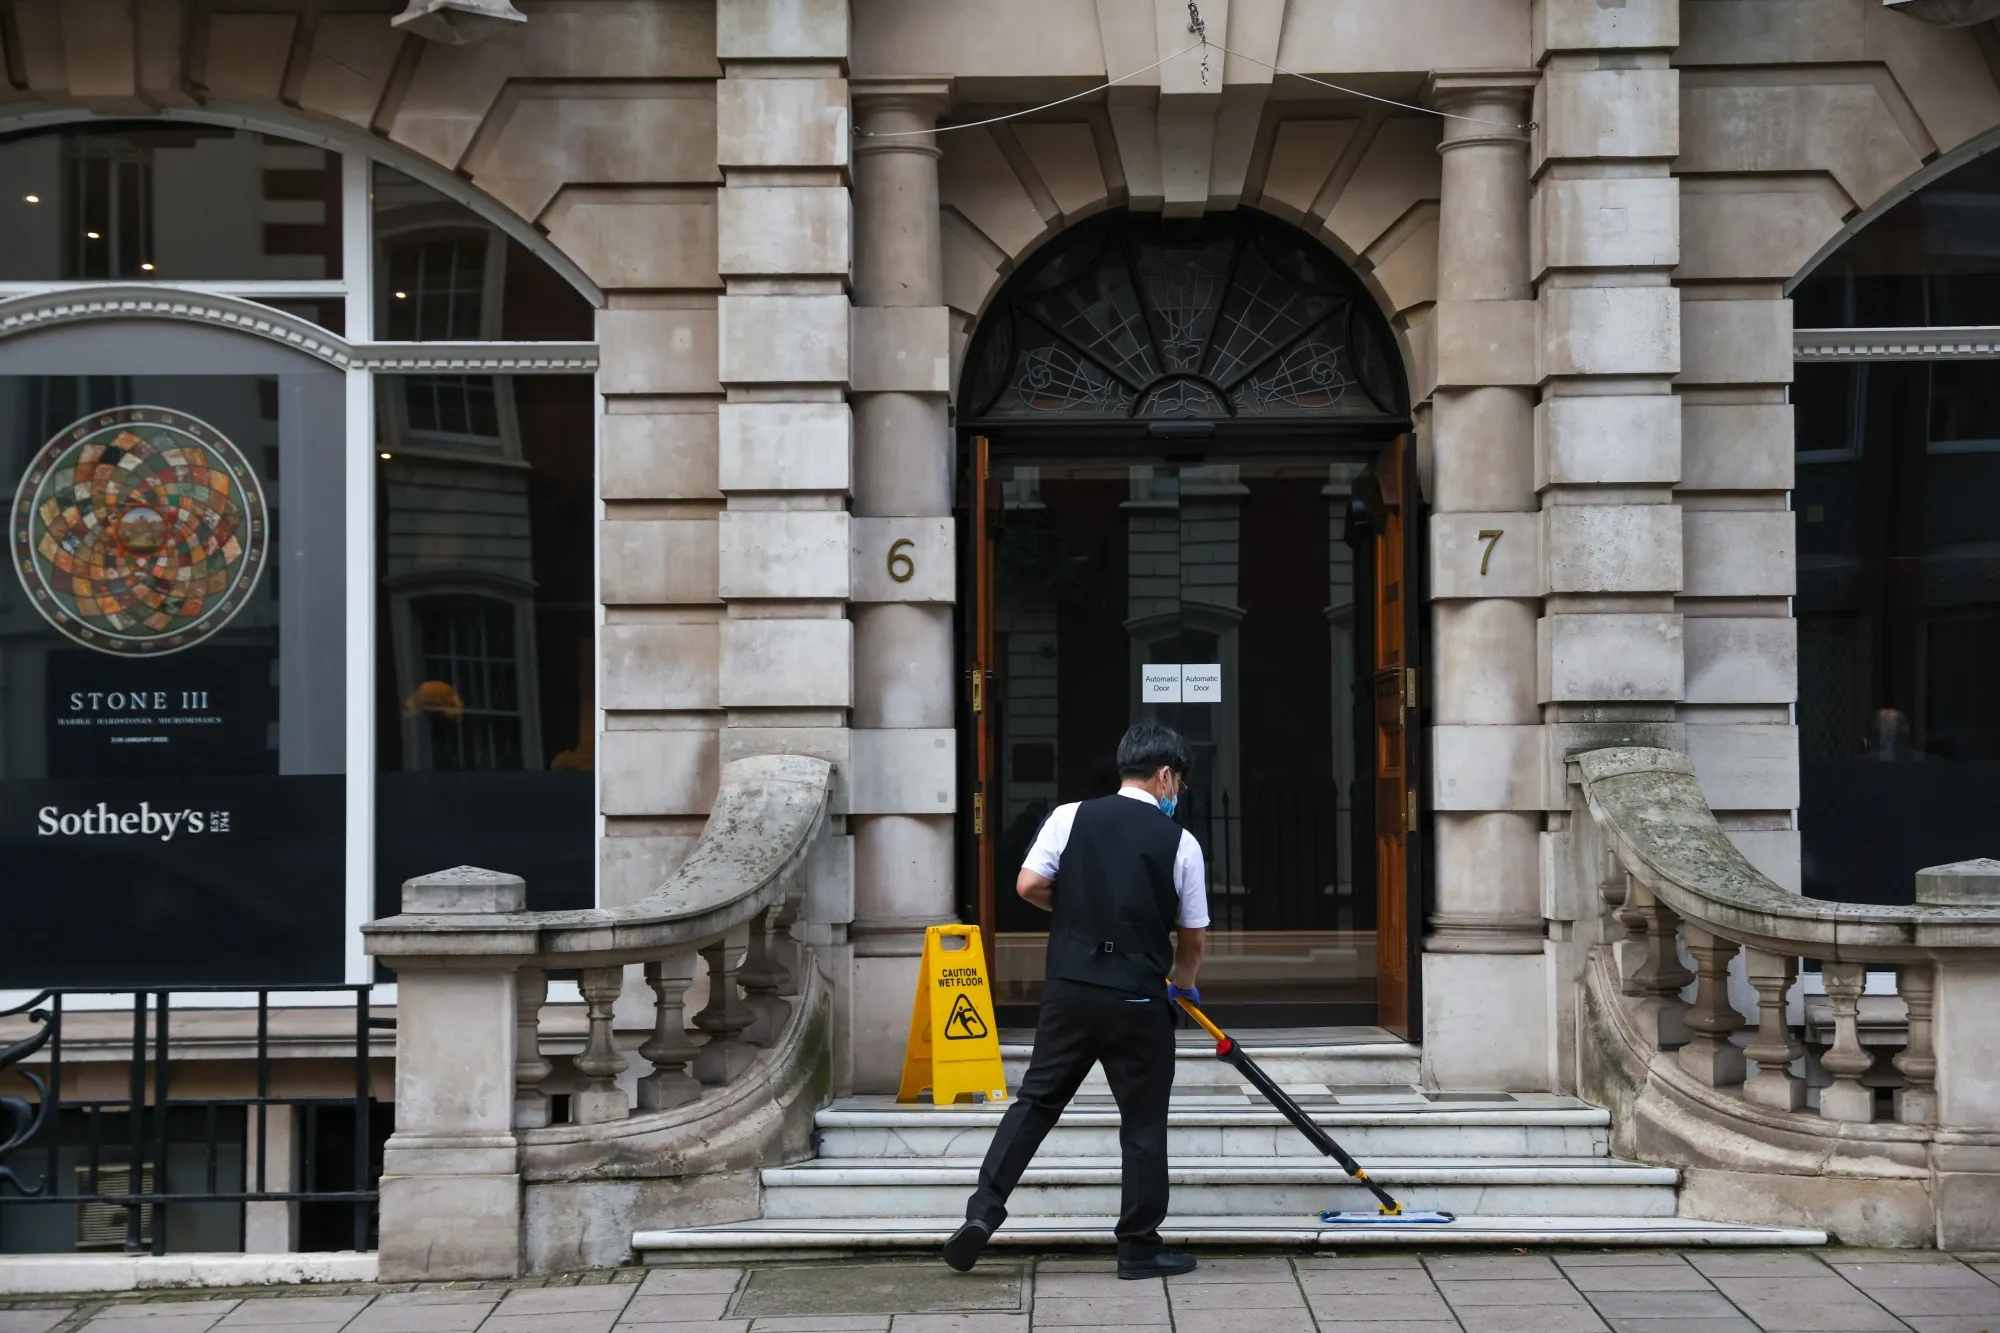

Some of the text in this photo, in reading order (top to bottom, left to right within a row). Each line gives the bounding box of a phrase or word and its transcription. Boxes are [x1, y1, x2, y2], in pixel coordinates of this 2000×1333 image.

[887, 538, 916, 584] 6
[1478, 529, 1504, 576] 7
[70, 692, 208, 710] STONE III
[38, 801, 205, 842] Sotheby's
[220, 811, 230, 833] 1744
[938, 977, 983, 987] WET FLOOR
[942, 968, 977, 977] CAUTION
